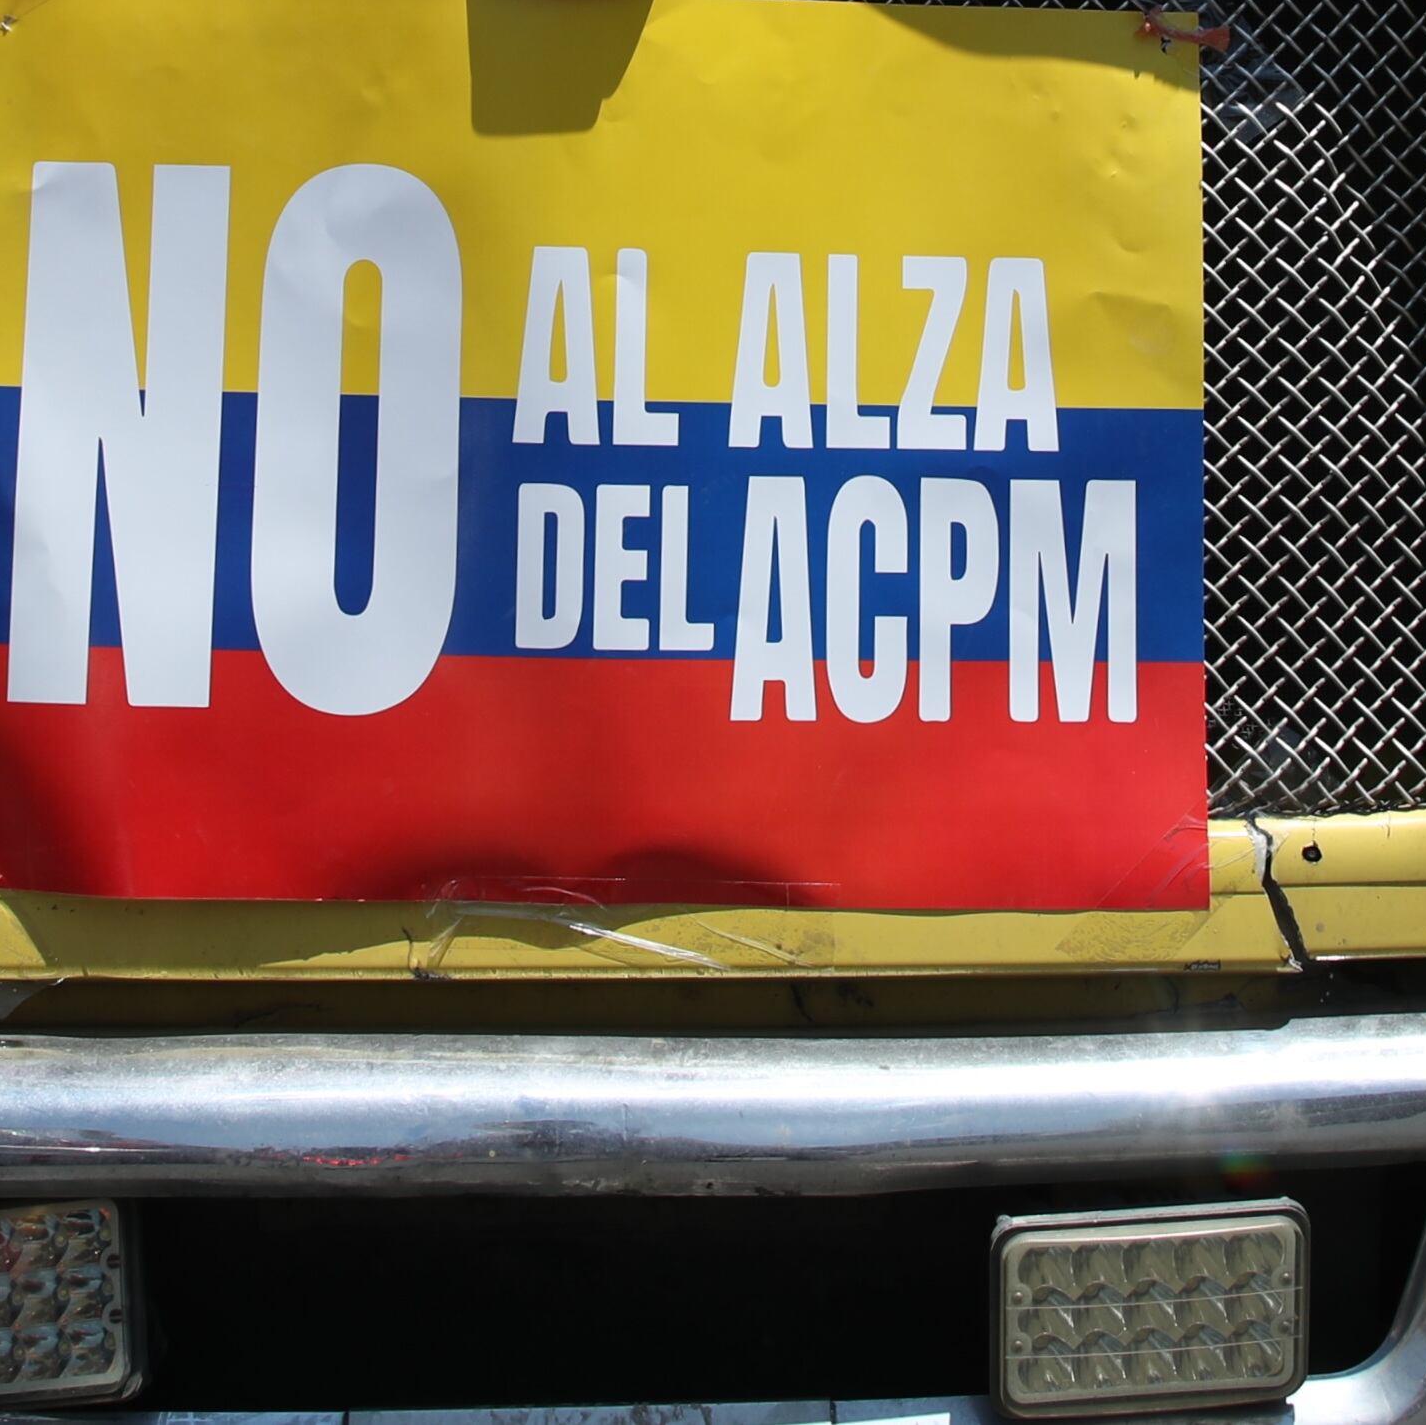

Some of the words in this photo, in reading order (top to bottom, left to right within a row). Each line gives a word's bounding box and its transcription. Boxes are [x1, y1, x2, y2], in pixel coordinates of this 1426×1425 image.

[8, 161, 463, 715] NO
[513, 246, 679, 447] AL
[729, 252, 1059, 452] ALZA
[516, 483, 714, 651] DEL
[731, 476, 1137, 723] ACPM
